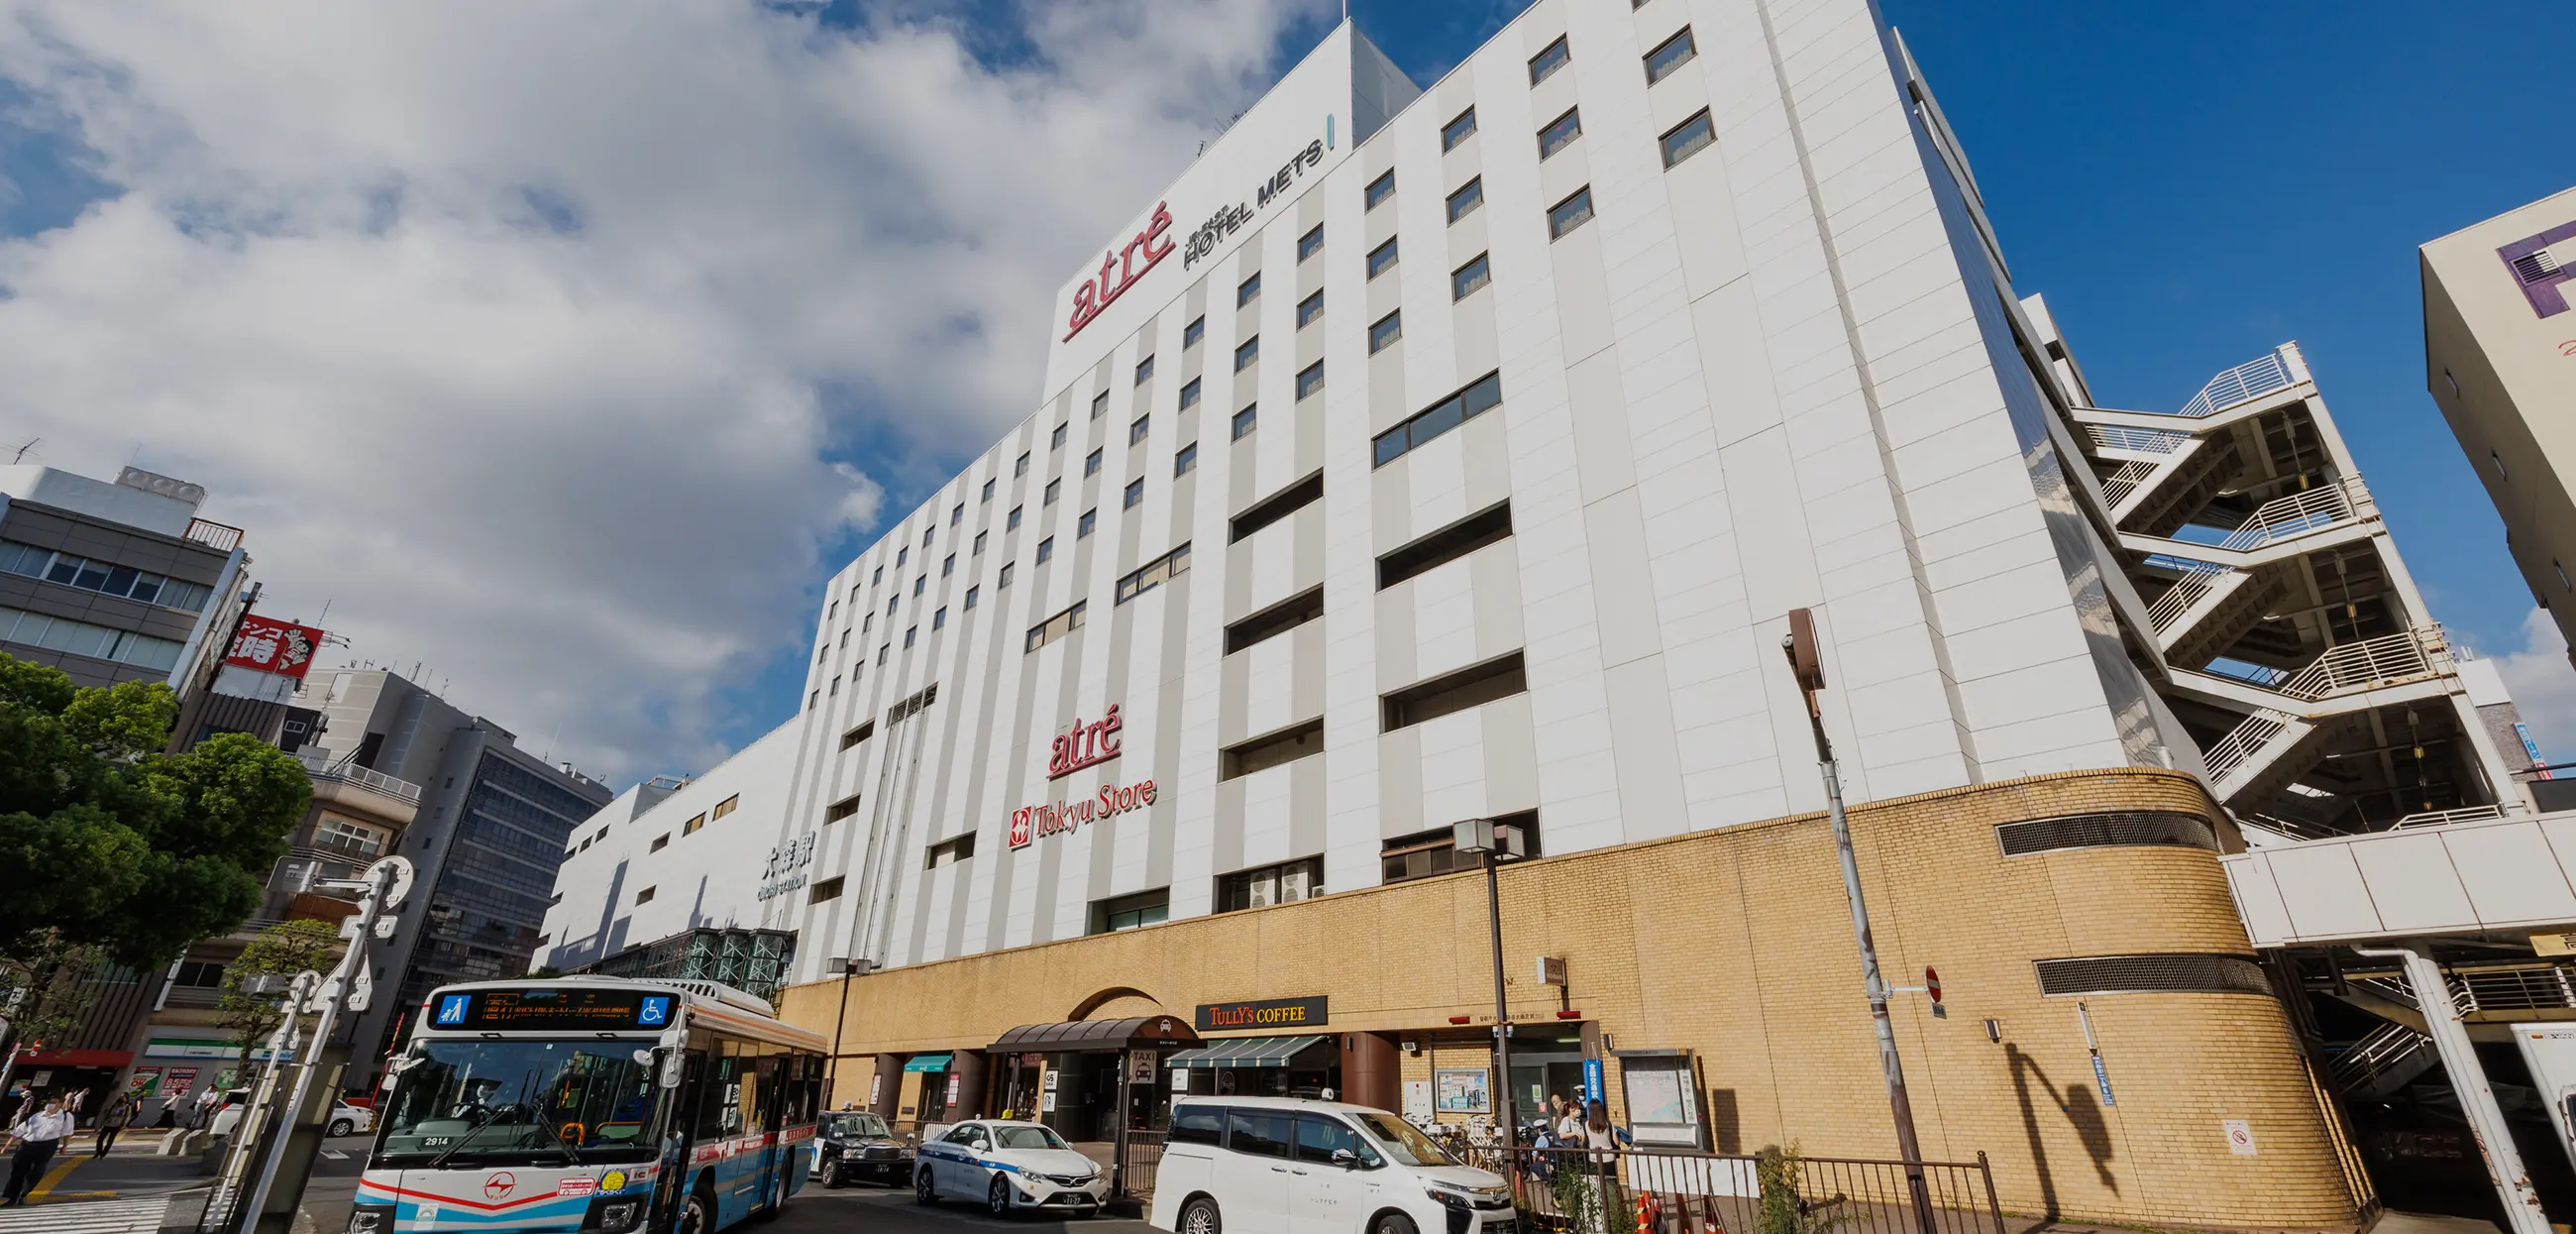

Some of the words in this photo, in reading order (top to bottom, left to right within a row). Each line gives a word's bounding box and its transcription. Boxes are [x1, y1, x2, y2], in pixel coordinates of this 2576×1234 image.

[1184, 201, 1254, 272] HOTEL
[1257, 137, 1324, 209] METS
[1066, 200, 1174, 335] atré
[1048, 703, 1123, 774] atré
[1034, 799, 1095, 839] Tokyu
[1097, 778, 1157, 820] Store
[1256, 1006, 1306, 1024] COFFEE
[1134, 1052, 1155, 1061] TAXI
